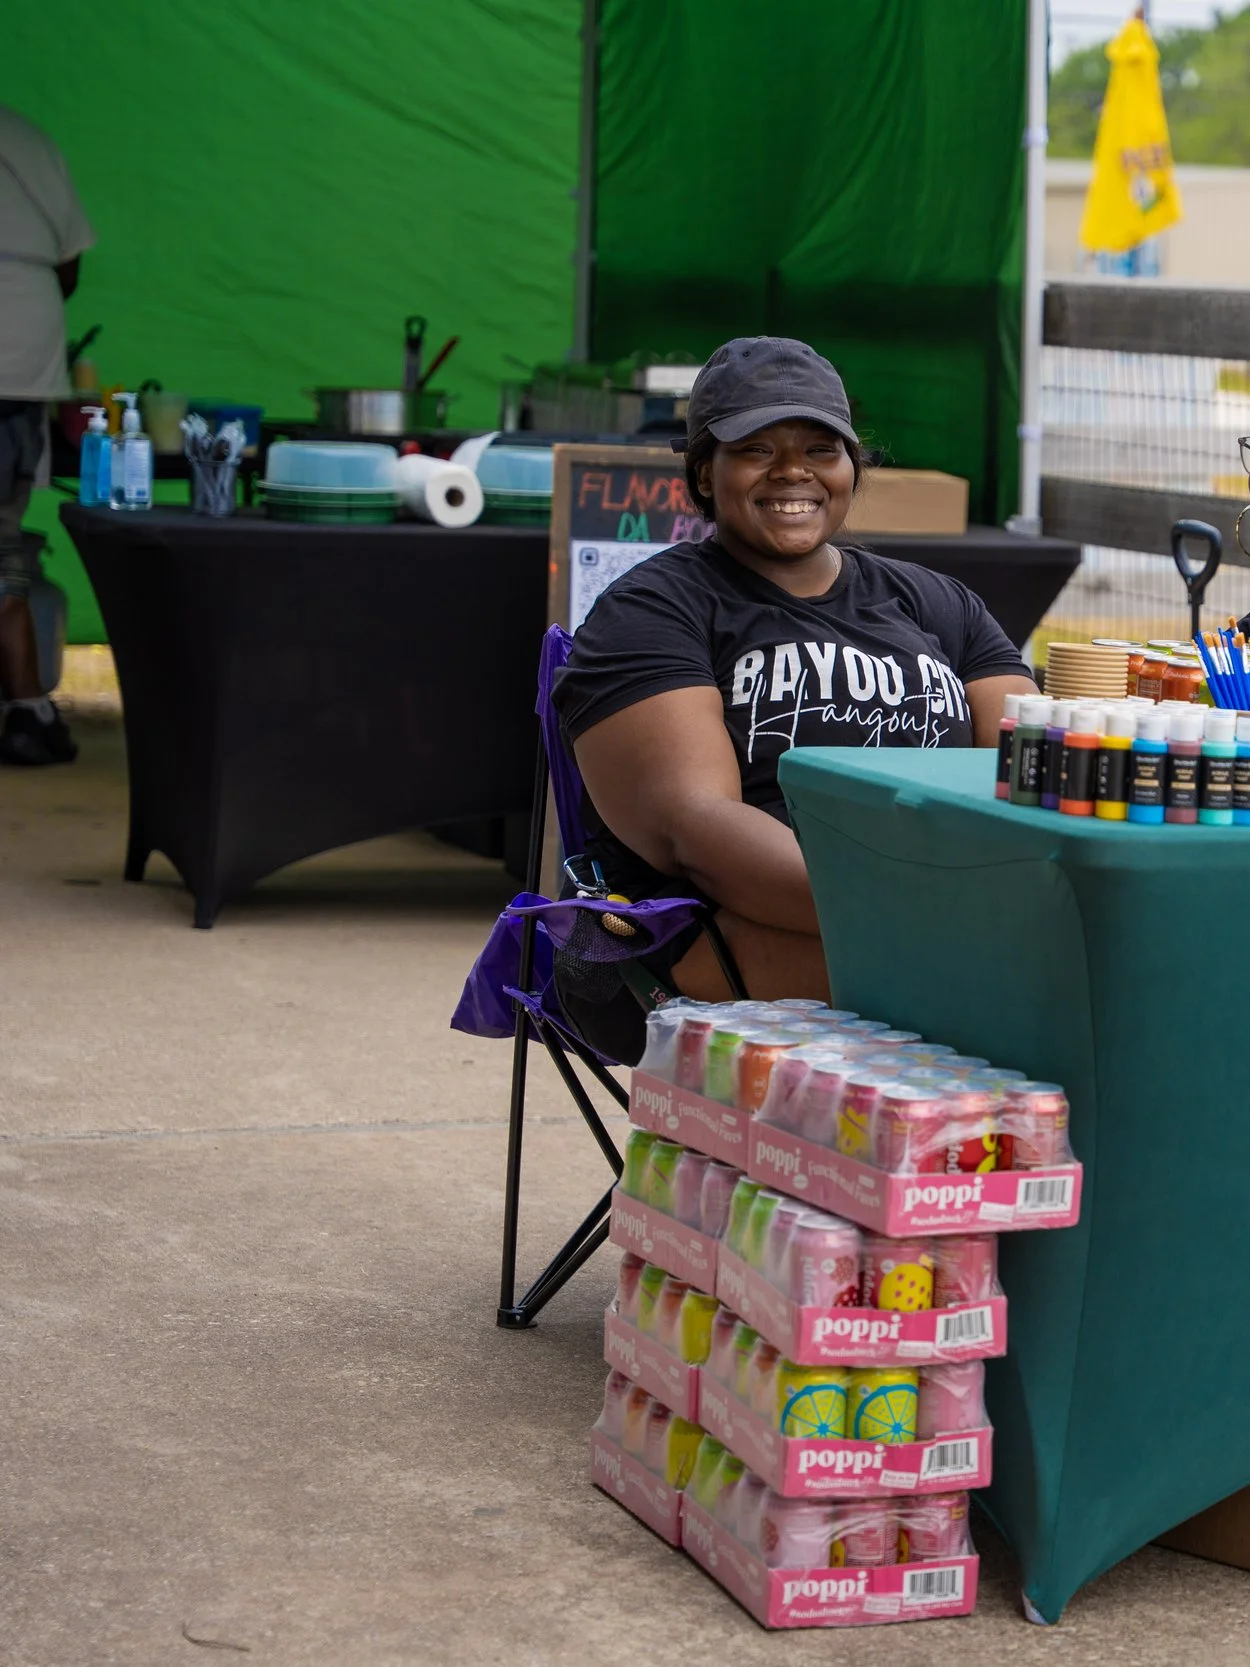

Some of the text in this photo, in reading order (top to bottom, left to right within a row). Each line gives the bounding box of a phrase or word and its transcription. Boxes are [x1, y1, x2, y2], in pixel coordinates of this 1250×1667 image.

[617, 512, 650, 543] DA
[731, 642, 905, 706] BAYOU
[635, 1085, 672, 1118] poppi
[756, 1141, 801, 1176] poppi
[904, 1176, 984, 1212] poppi
[615, 1208, 648, 1240] poppi
[812, 1313, 902, 1343] poppi
[798, 1444, 883, 1474] poppi
[783, 1570, 868, 1604] poppi
